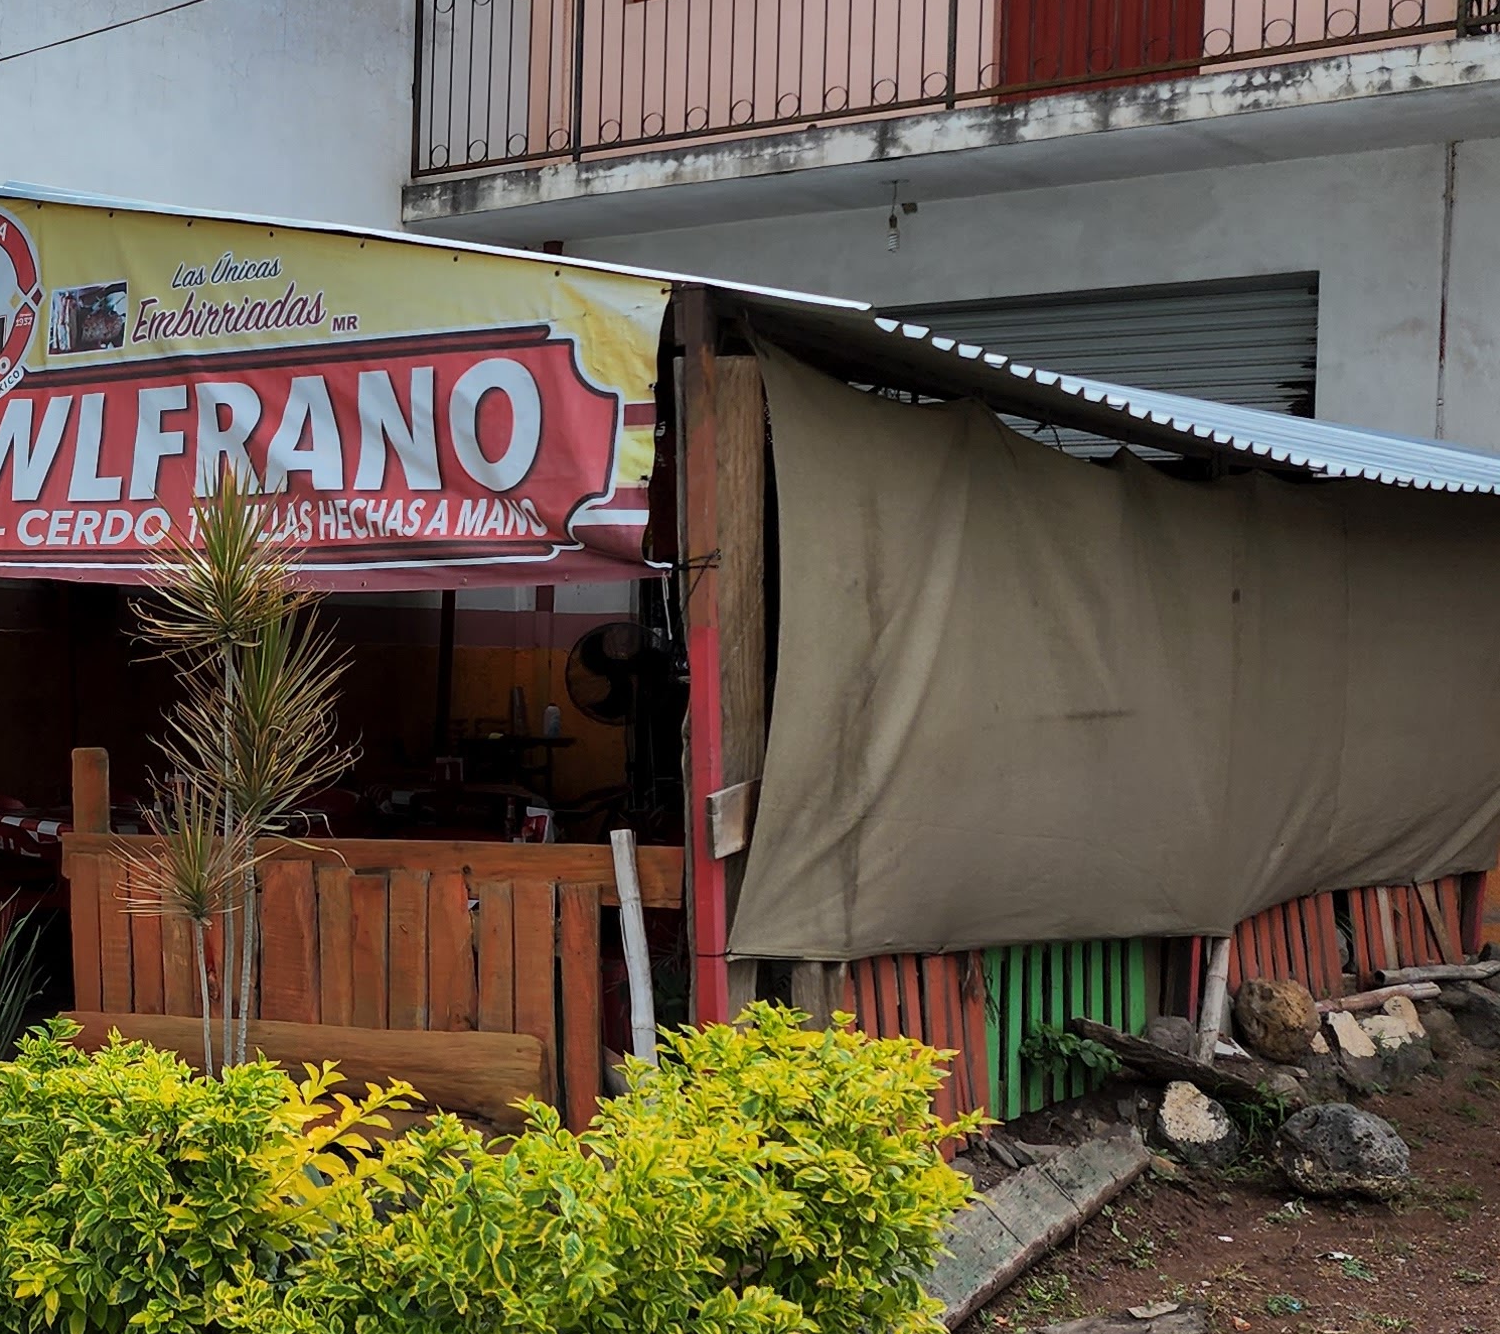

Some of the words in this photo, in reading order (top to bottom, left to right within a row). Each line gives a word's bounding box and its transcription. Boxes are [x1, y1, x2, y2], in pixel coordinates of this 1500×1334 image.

[172, 263, 206, 288] Las
[211, 252, 282, 284] Únicas
[133, 282, 327, 344] Embirriadas
[332, 316, 358, 332] MR
[17, 507, 171, 547] CERDO
[319, 498, 425, 541] HECHAS
[425, 499, 449, 536] A
[454, 498, 549, 538] MANO
